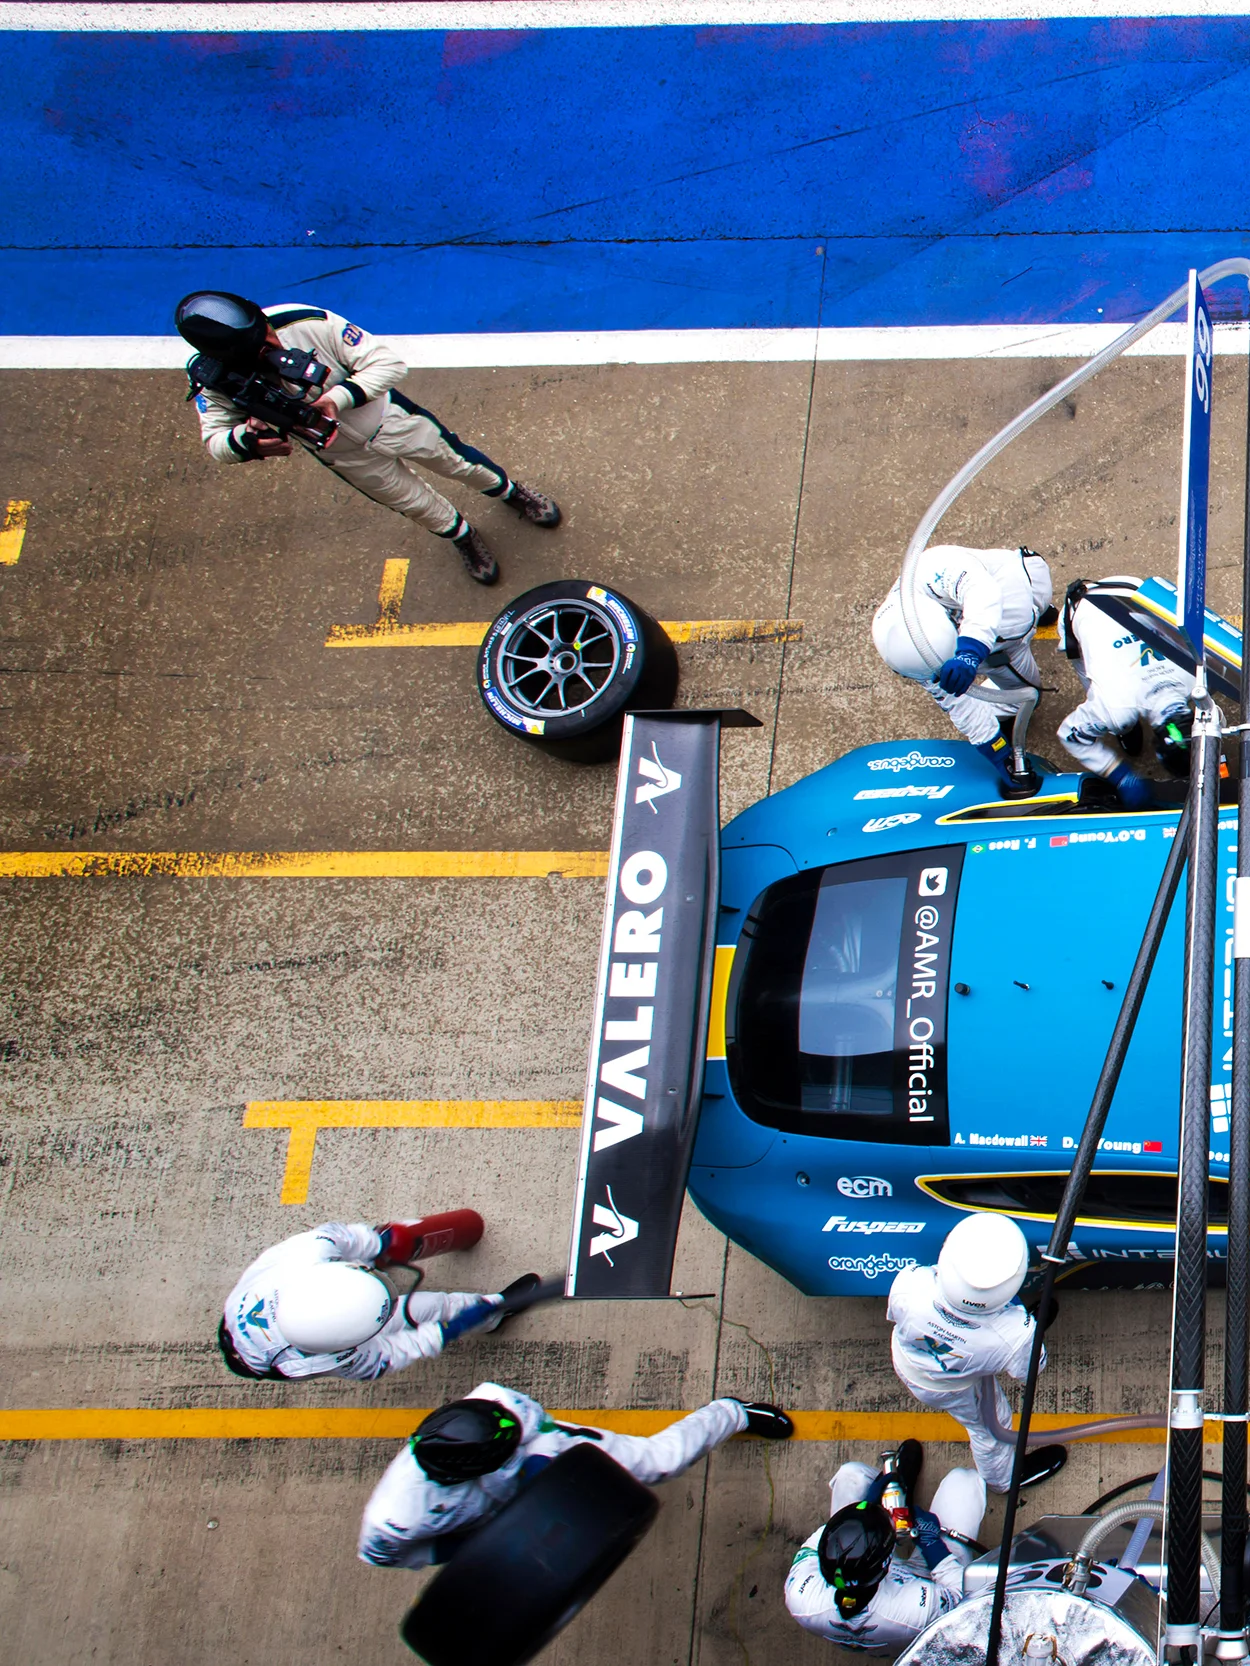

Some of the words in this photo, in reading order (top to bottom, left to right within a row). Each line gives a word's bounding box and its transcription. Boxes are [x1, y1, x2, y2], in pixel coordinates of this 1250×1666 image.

[594, 850, 668, 1153] VALERO
[906, 905, 940, 1123] @AMR_Official
[969, 1133, 1029, 1147] Macdowall
[837, 1176, 893, 1198] ecm
[962, 1298, 987, 1309] uvex
[927, 1321, 946, 1334] ASTON
[946, 1329, 968, 1344] MARTIN
[933, 1330, 955, 1344] RACING
